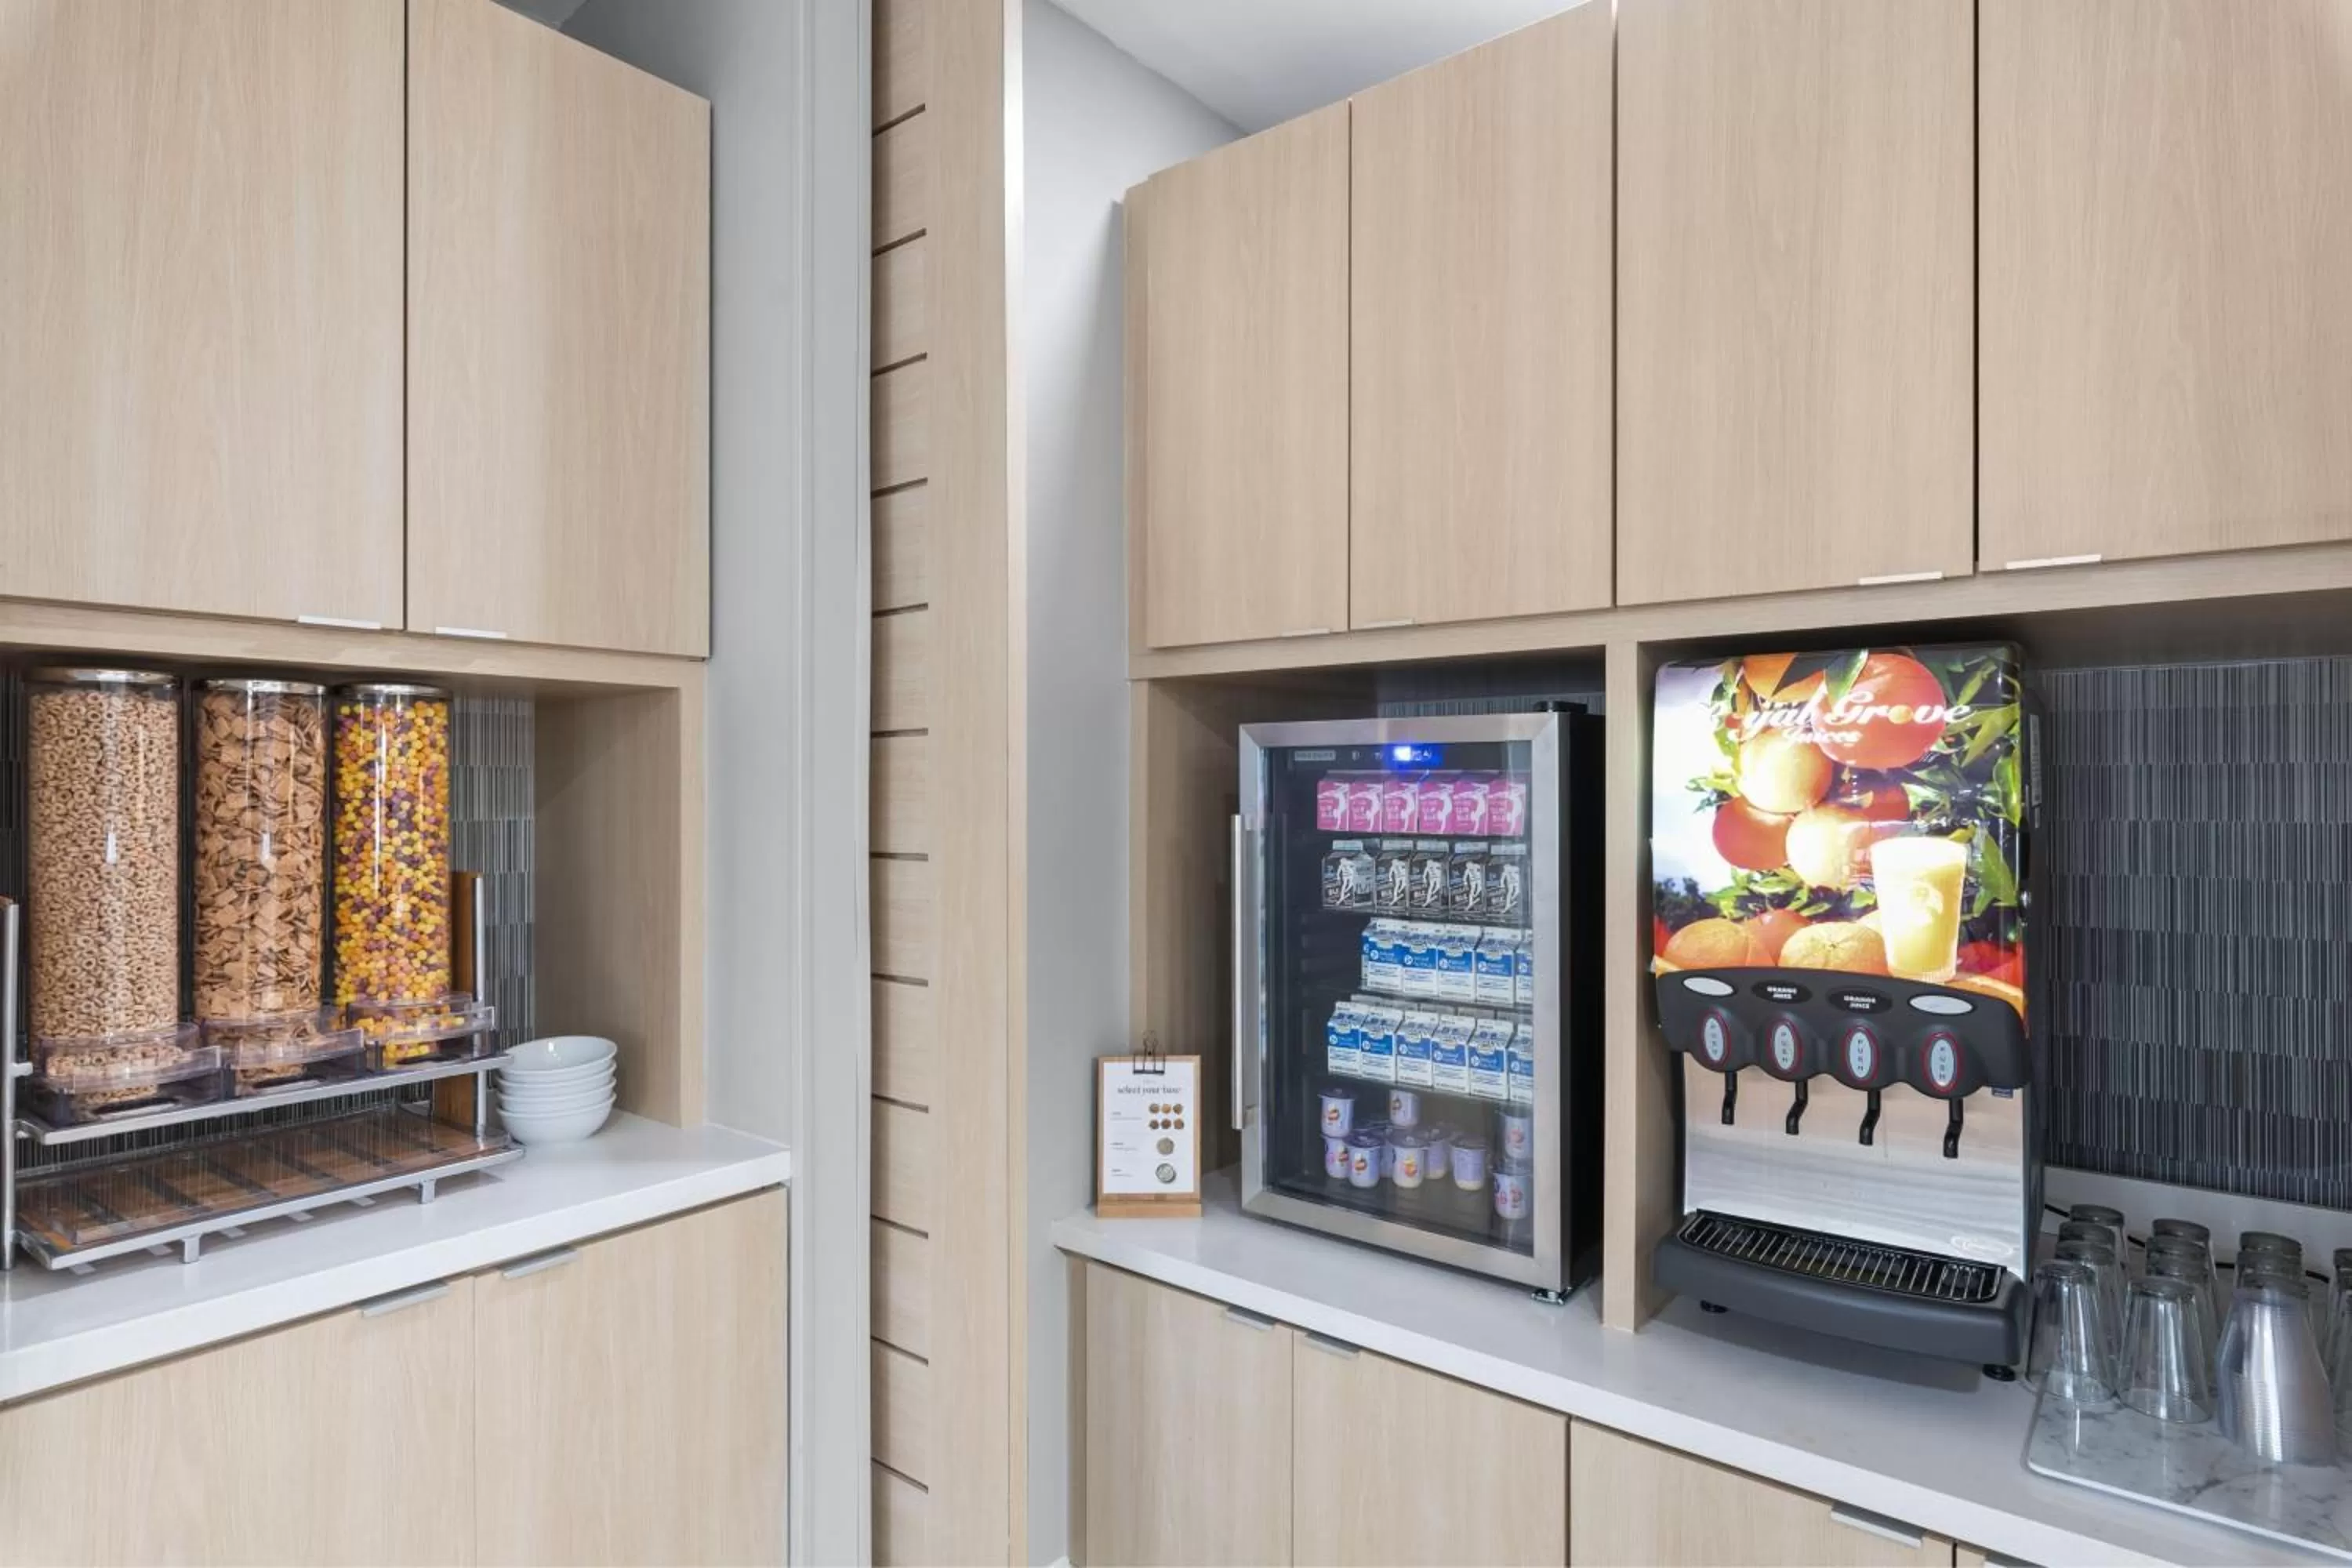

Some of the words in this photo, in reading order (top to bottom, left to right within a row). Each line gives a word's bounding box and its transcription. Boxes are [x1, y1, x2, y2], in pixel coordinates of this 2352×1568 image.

[1701, 681, 1828, 743] yal
[1824, 690, 1976, 724] Grove
[1766, 985, 1798, 994] ORANGE
[1843, 995, 1876, 1004] ORANGE
